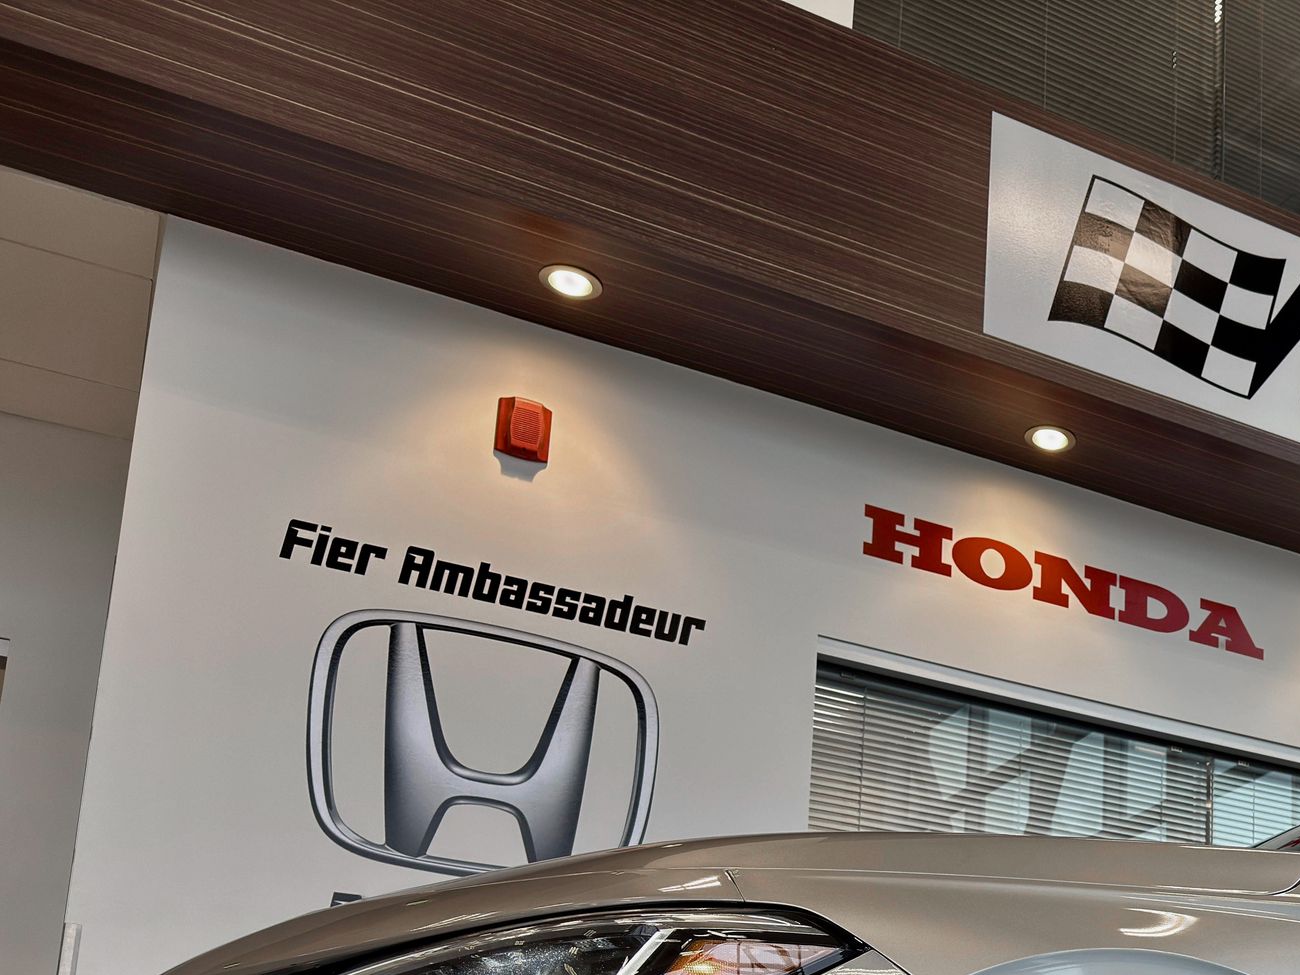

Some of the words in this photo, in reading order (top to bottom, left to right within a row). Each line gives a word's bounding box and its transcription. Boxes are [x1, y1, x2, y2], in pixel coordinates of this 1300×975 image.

[279, 518, 388, 576] Fier
[397, 545, 707, 646] Ambassadeur
[862, 504, 1265, 661] HONDA
